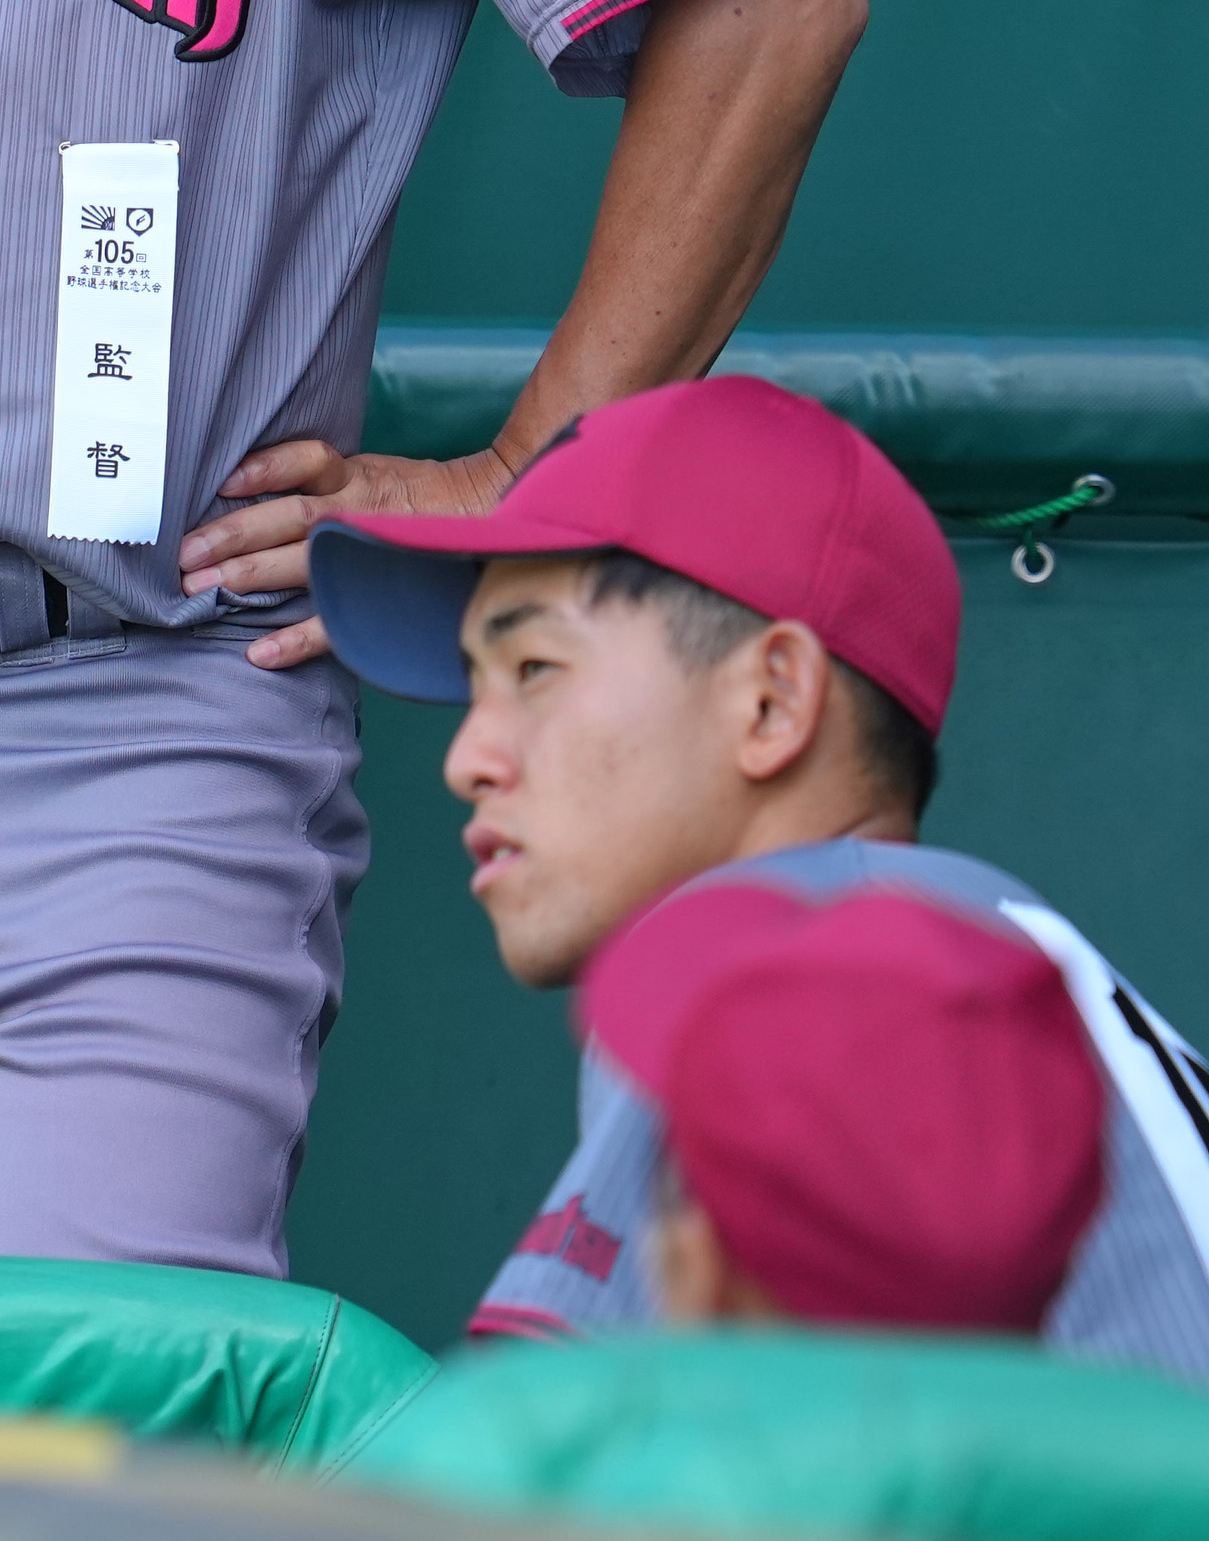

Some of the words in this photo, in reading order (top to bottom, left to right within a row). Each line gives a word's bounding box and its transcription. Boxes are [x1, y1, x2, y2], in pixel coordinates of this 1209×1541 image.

[79, 264, 151, 279] 全国高等学校
